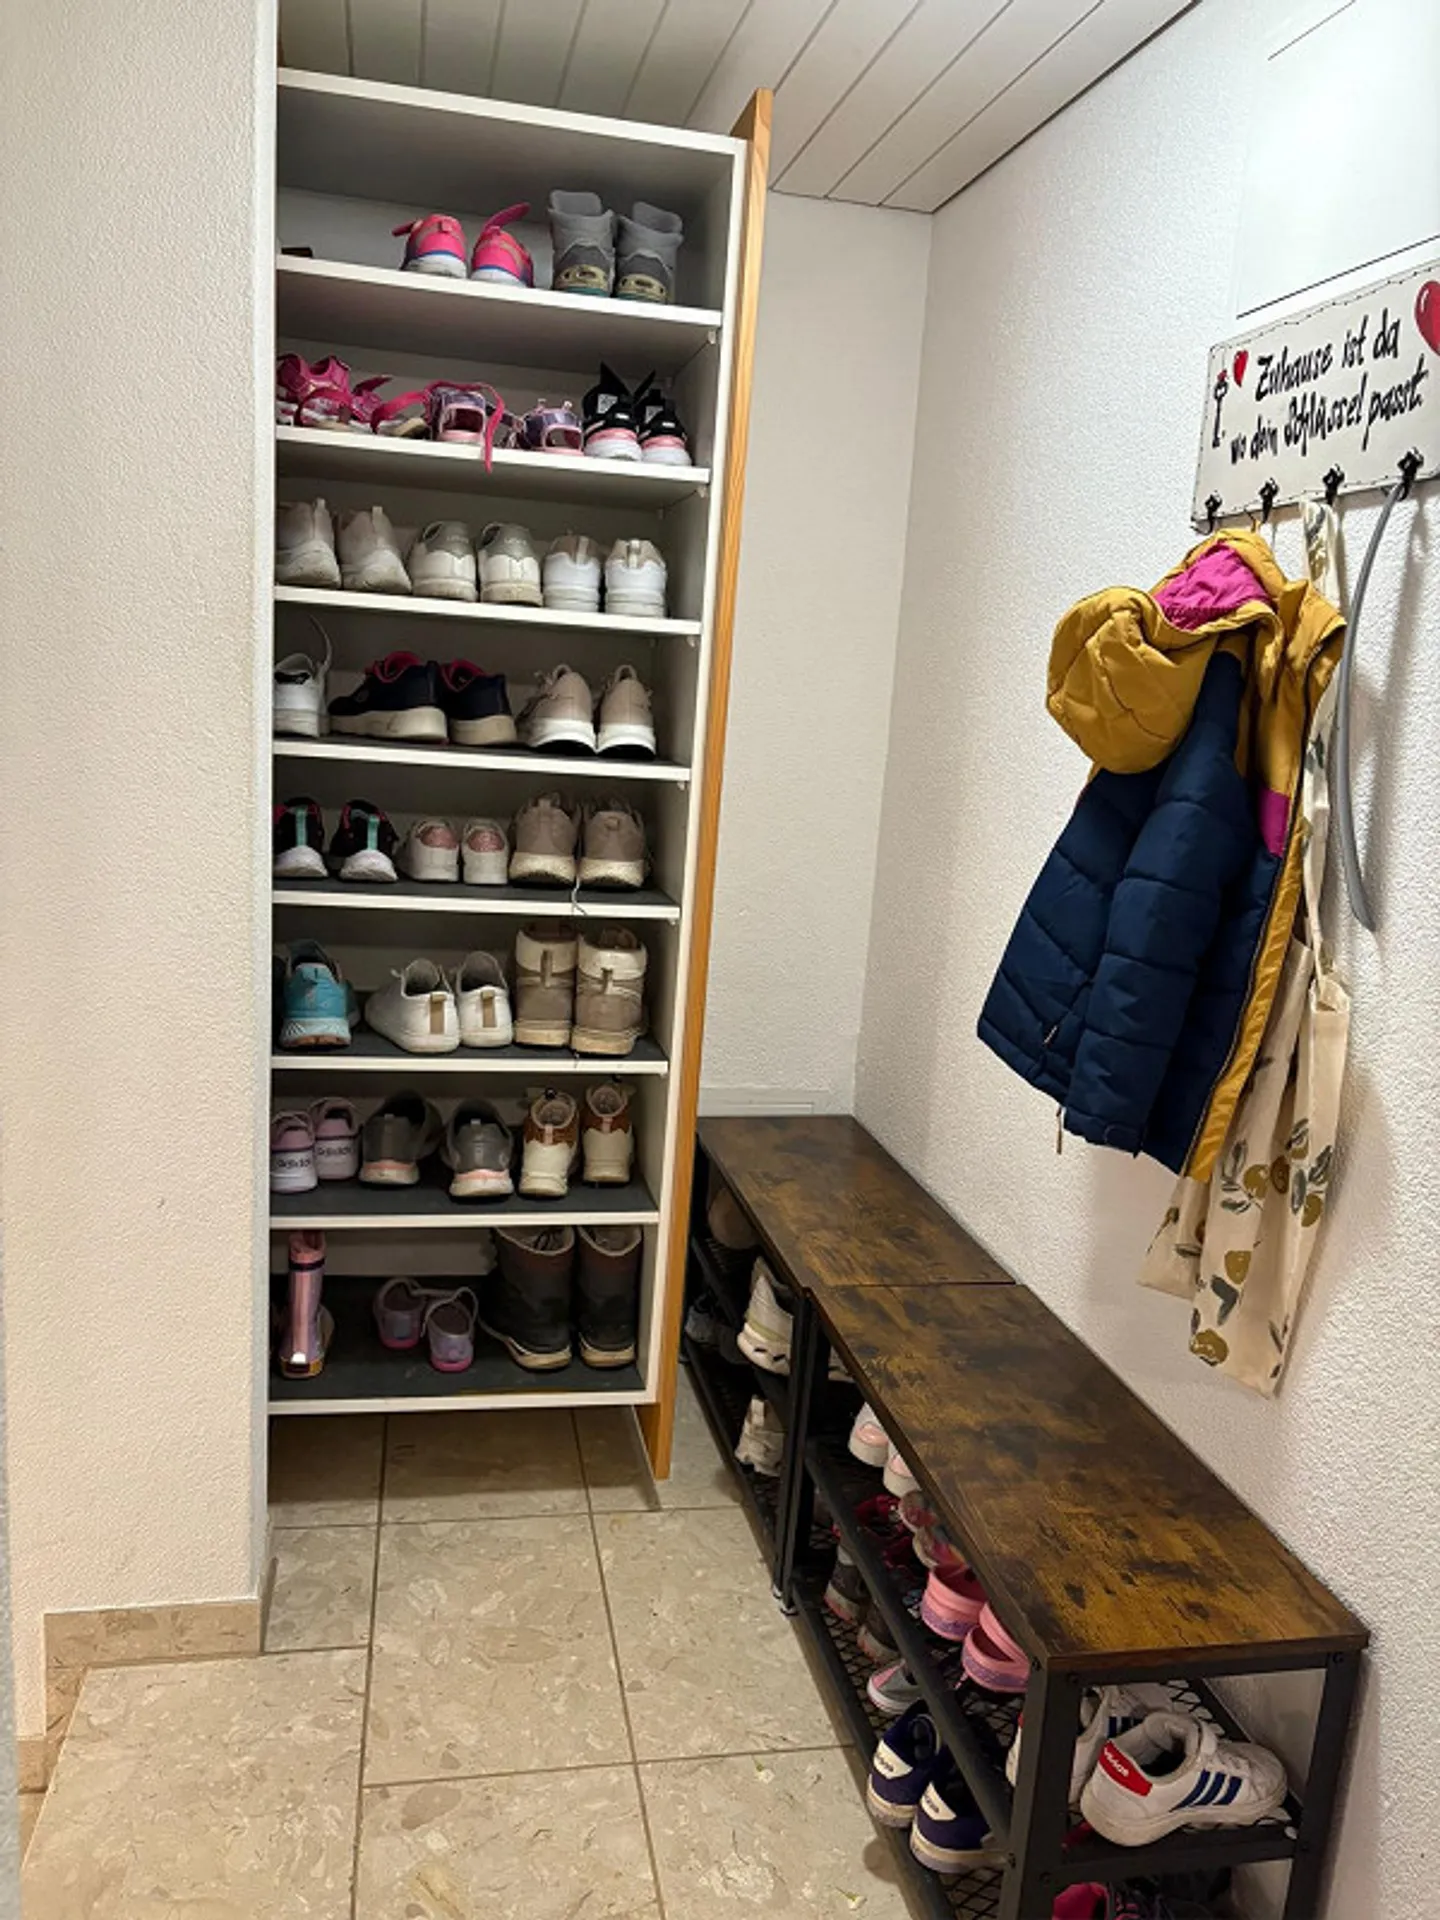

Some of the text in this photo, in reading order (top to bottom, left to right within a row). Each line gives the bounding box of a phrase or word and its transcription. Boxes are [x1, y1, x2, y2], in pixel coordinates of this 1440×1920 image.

[1255, 307, 1401, 402] Zuhause ist da
[1250, 414, 1278, 460] dein
